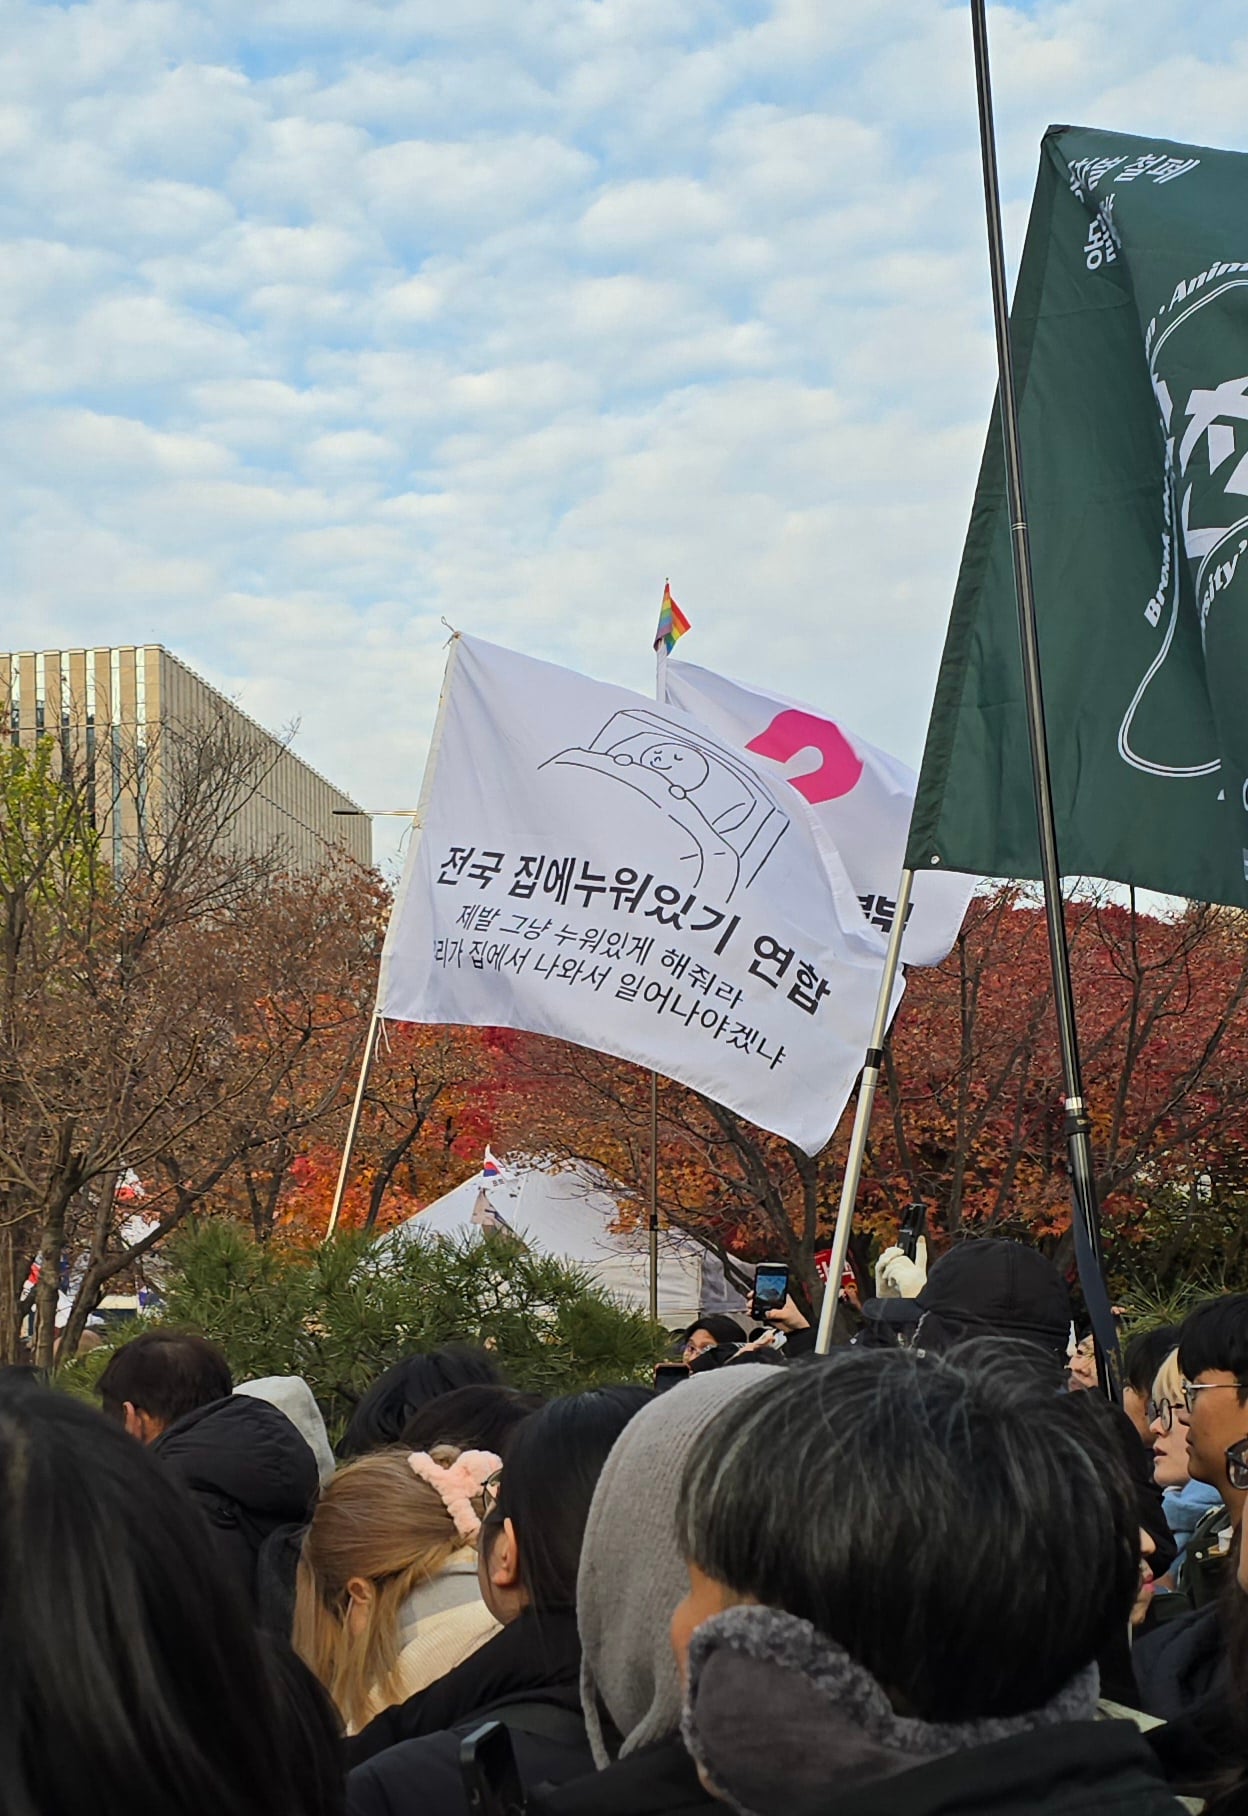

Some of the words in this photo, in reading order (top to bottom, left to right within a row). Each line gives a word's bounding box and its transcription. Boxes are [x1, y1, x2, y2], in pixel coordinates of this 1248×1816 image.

[437, 847, 505, 889] 전국
[508, 855, 741, 956] 집에누워있기
[748, 935, 831, 1015] 연합
[456, 904, 501, 932] 제발
[499, 914, 552, 940] 그냥
[554, 924, 655, 966] 누워있게
[661, 949, 743, 1009] 해줘라
[434, 937, 464, 969] 리가
[468, 940, 532, 974] 집에서
[534, 953, 612, 990] 나와서
[615, 973, 786, 1070] 일어나야겠냐
